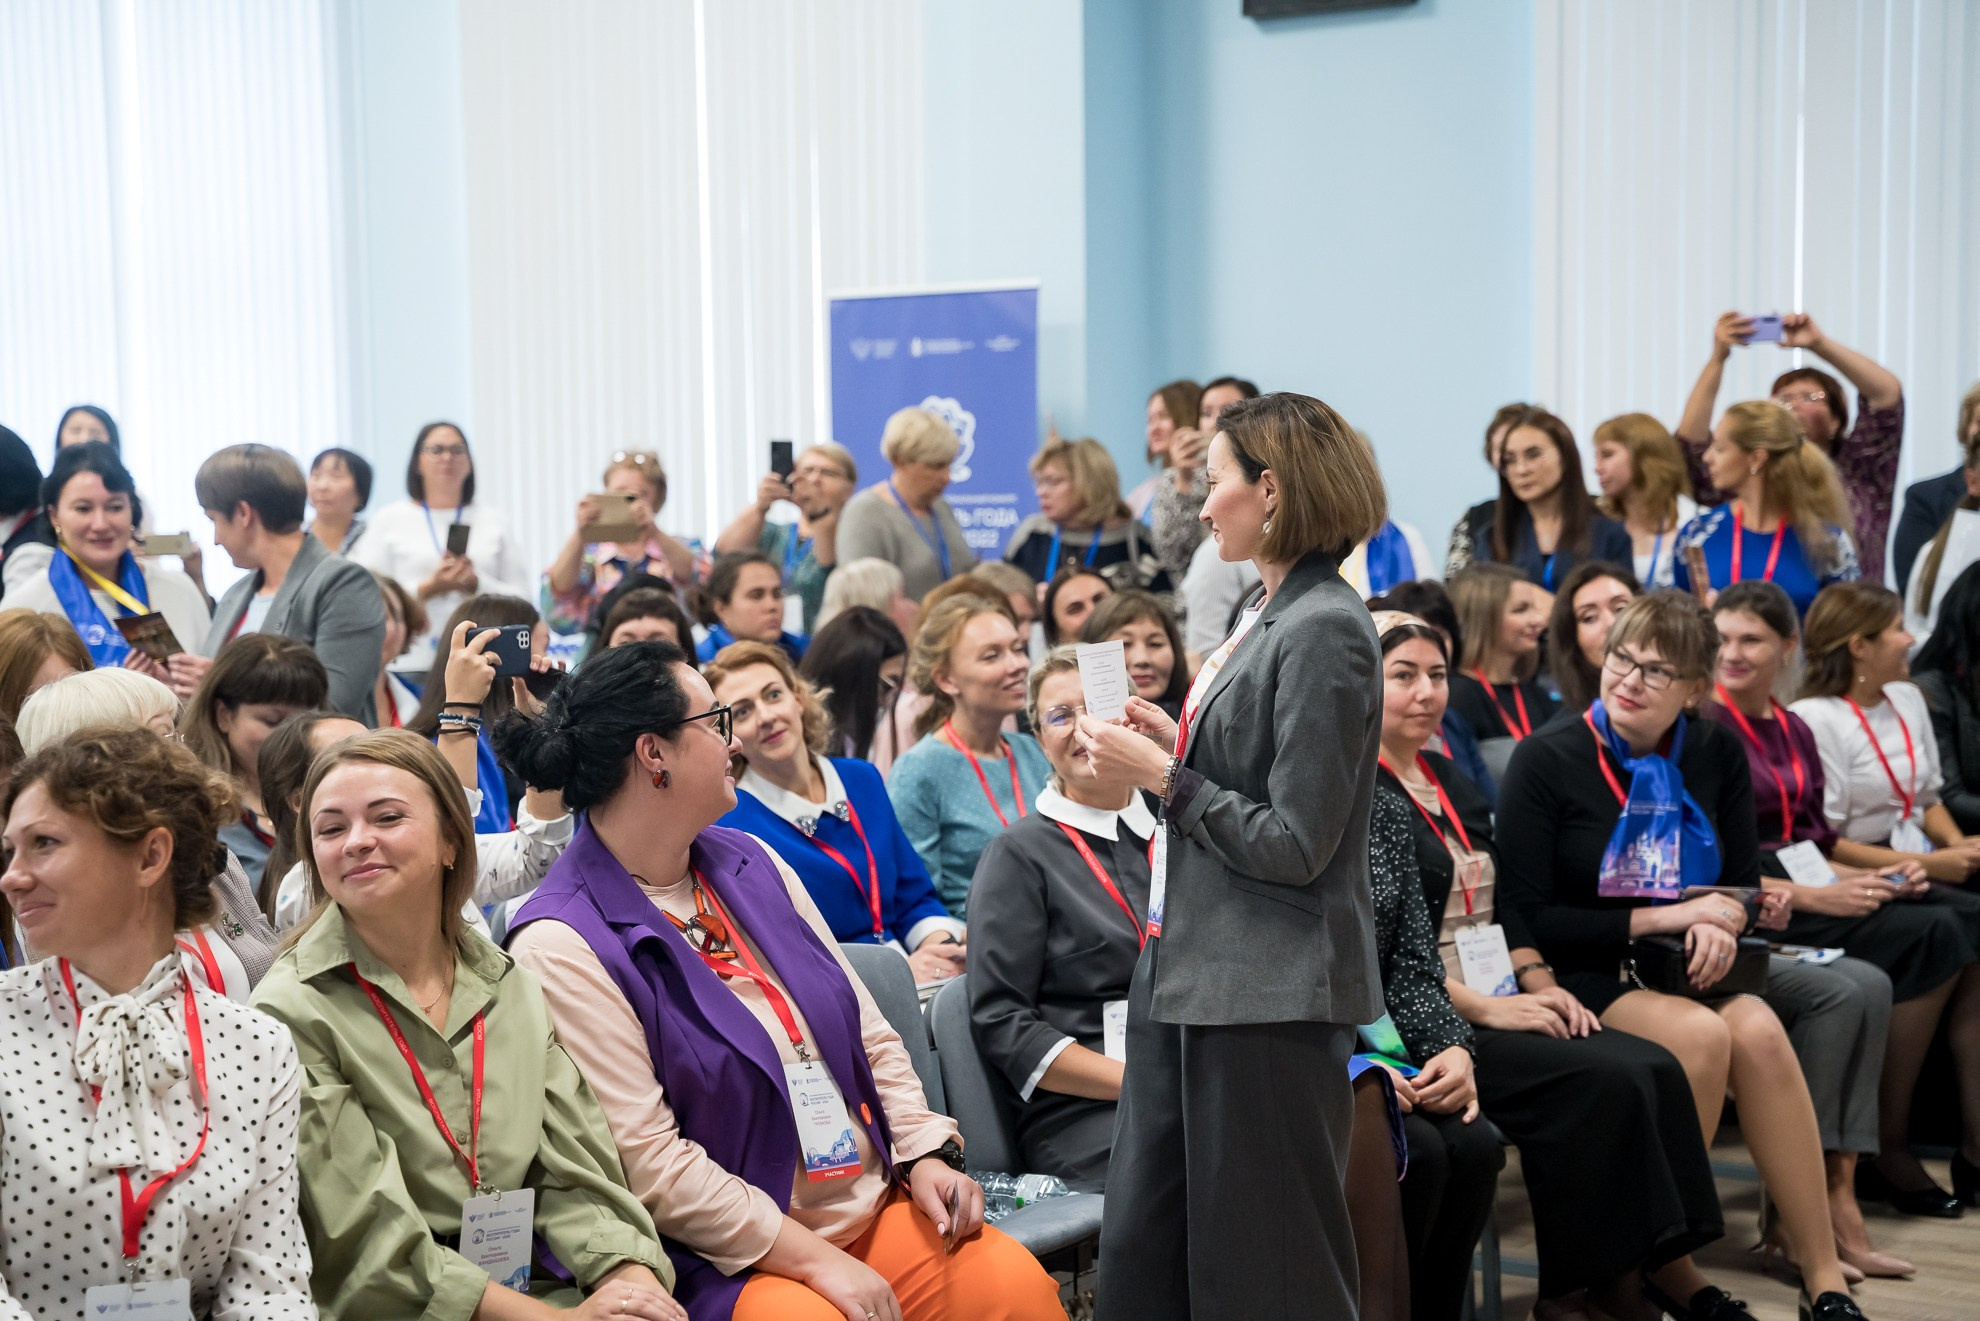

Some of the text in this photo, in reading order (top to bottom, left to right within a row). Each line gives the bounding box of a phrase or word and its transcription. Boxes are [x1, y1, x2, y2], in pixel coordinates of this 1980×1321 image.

[972, 507, 1019, 528] ГОДА
[962, 529, 999, 548] 022
[370, 992, 409, 1054] ВОСПИТАТЕЛЬ ГОДА
